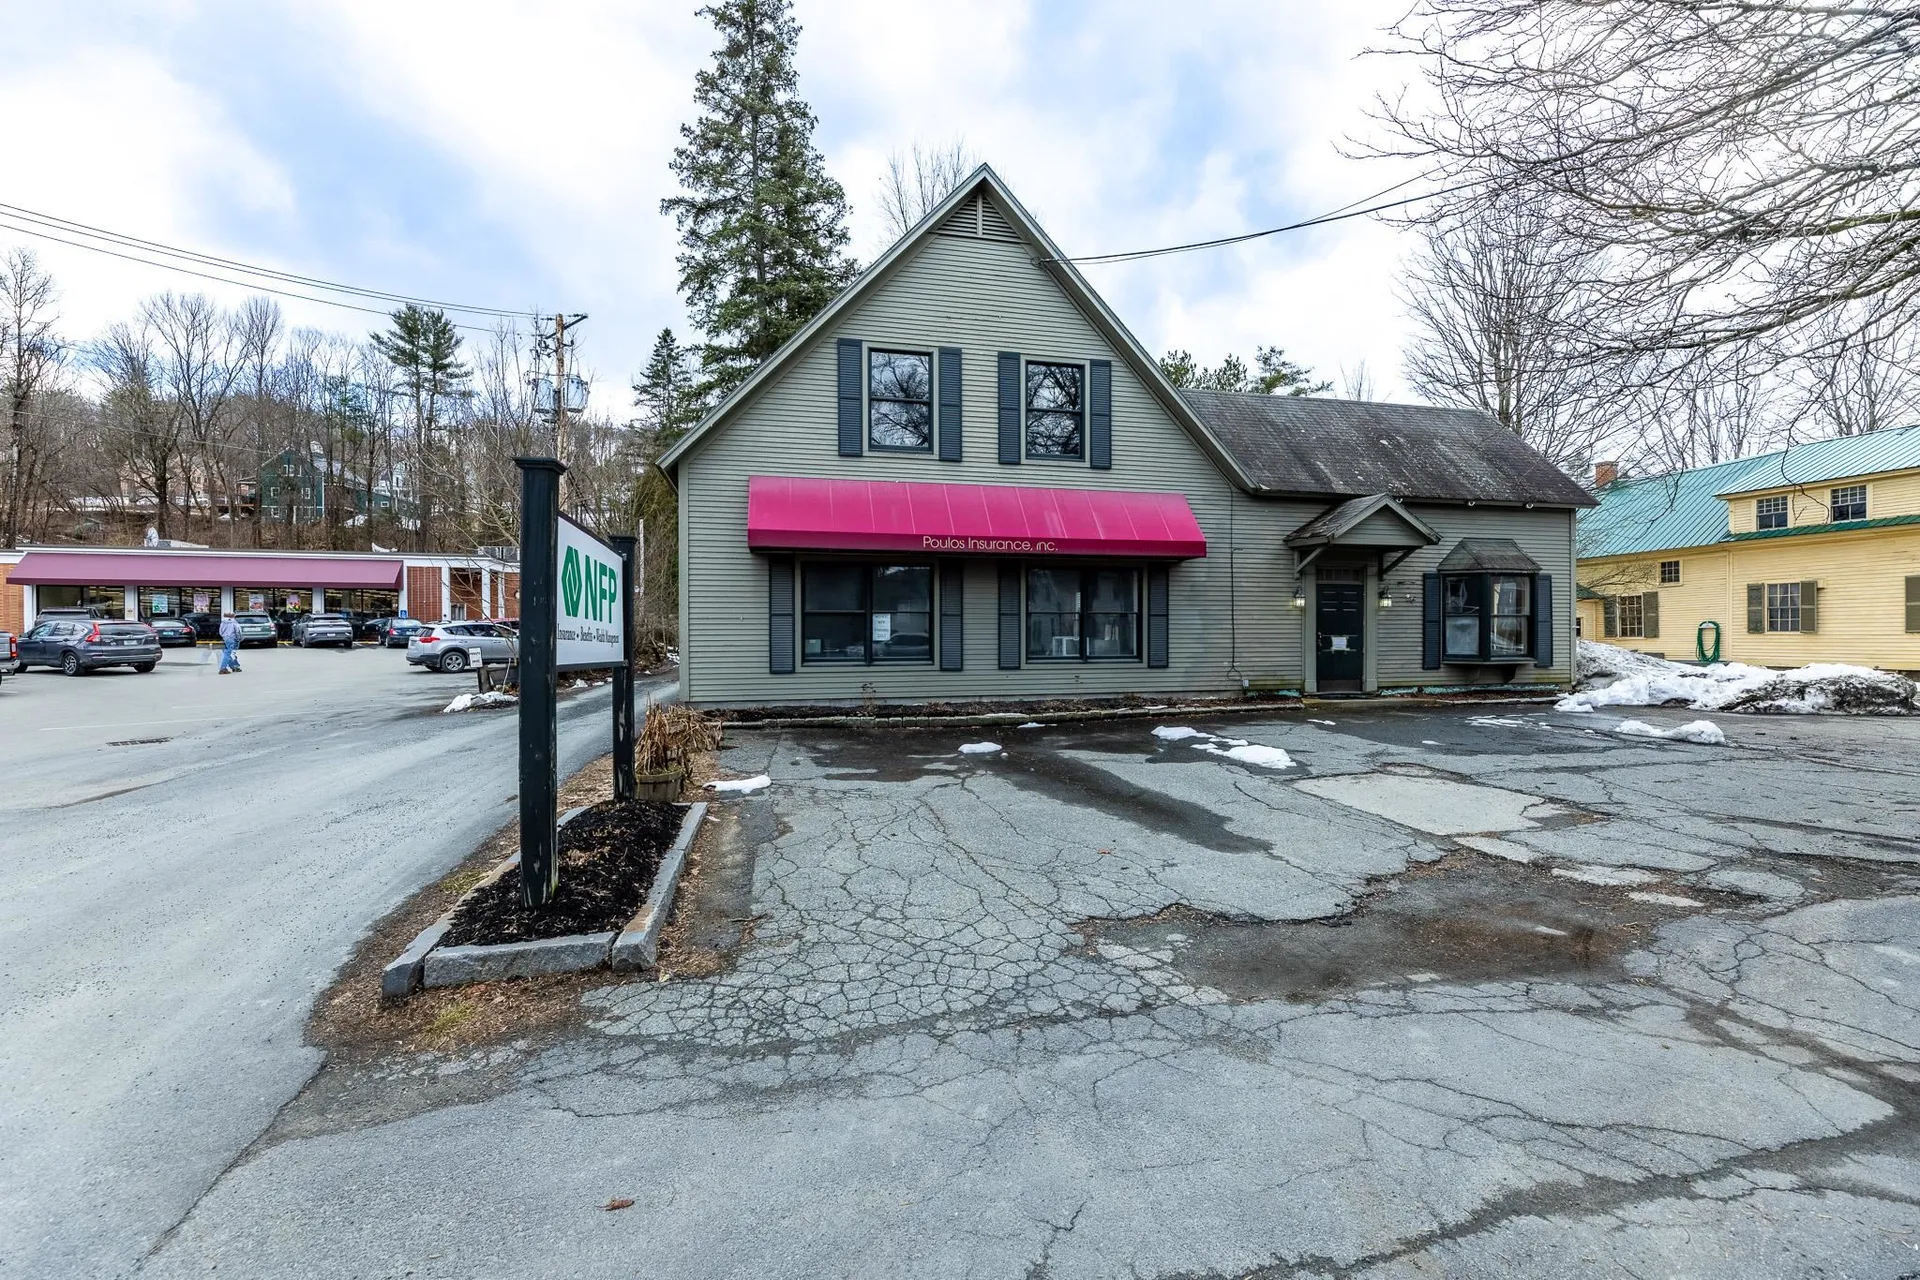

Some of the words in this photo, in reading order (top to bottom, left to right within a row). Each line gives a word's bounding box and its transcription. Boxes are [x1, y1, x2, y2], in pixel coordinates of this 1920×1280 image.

[923, 536, 965, 549] Poulos
[968, 537, 1033, 551] Insurance,
[585, 555, 617, 623] NFP
